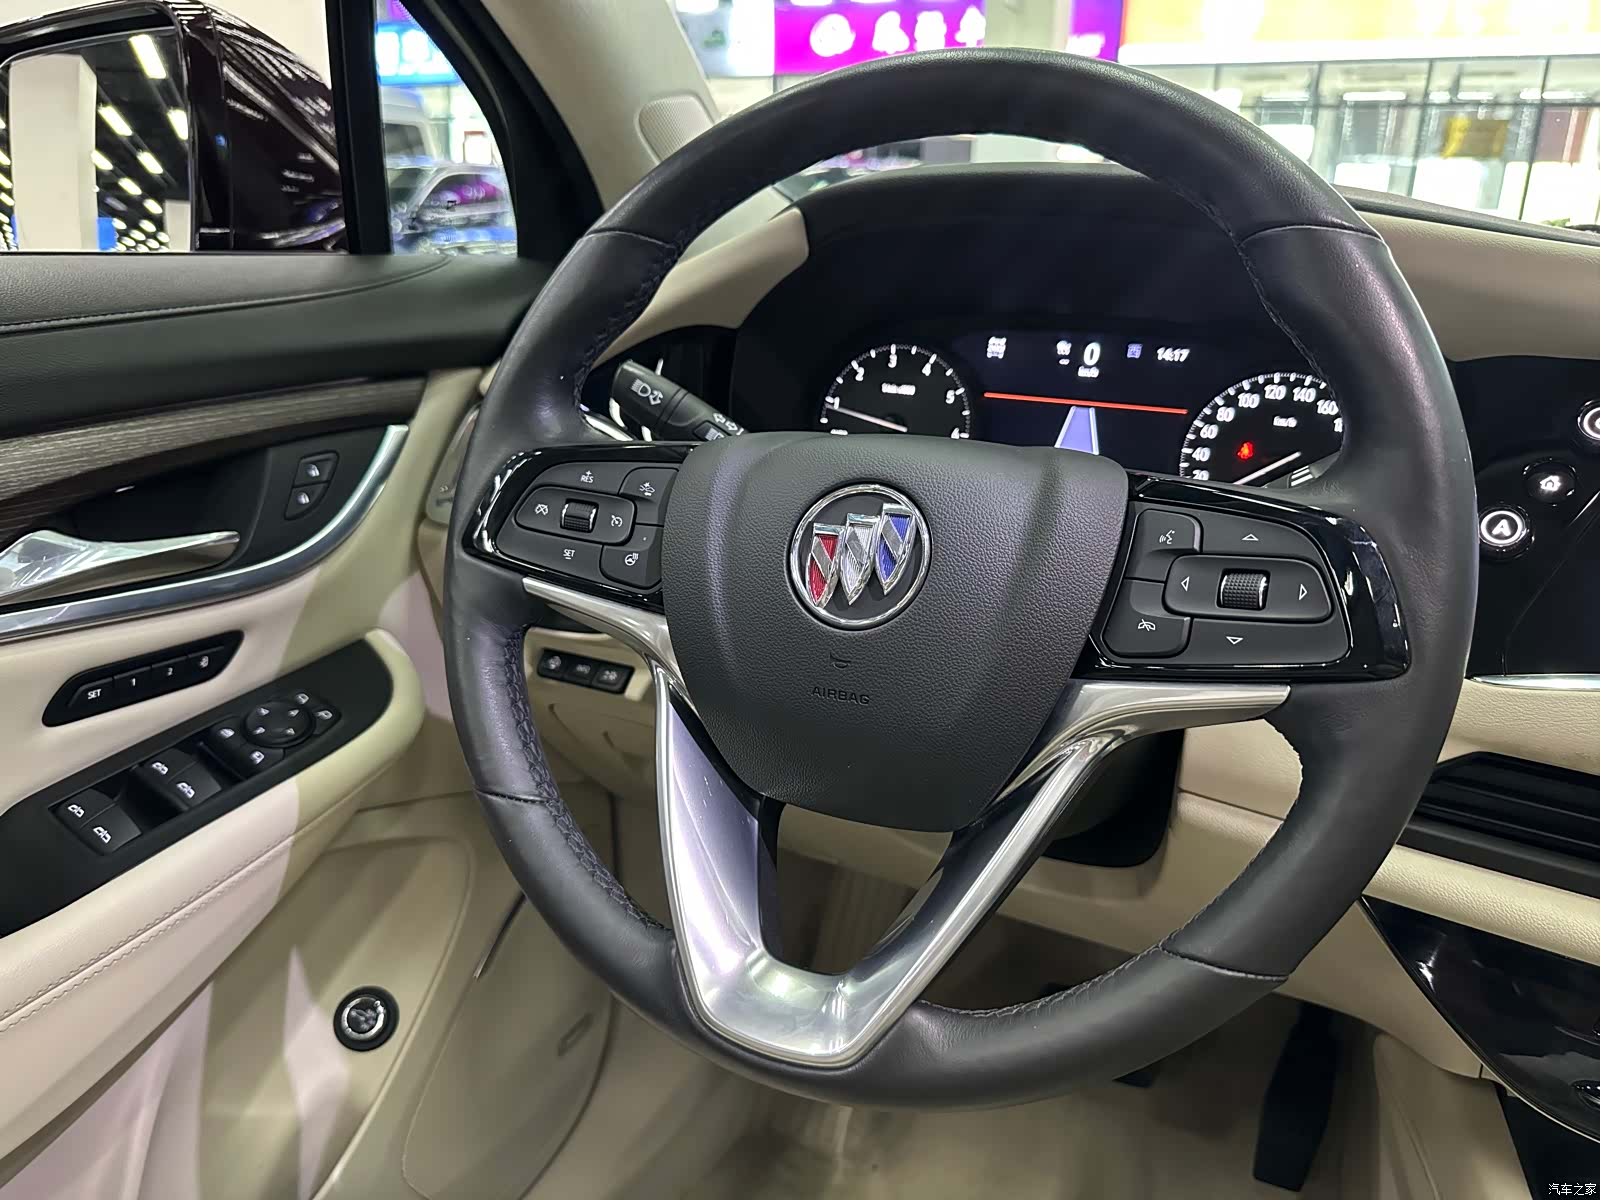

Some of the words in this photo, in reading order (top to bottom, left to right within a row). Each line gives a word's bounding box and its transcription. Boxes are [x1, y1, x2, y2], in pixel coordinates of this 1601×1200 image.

[888, 354, 898, 368] 3
[1083, 342, 1101, 366] 0
[1157, 347, 1190, 362] 14:17
[855, 366, 865, 382] 2
[922, 362, 932, 377] 4
[945, 389, 955, 404] 5
[1264, 384, 1287, 400] 120
[1293, 387, 1317, 403] 140
[833, 396, 840, 410] 1
[1237, 393, 1261, 409] 100
[1316, 399, 1339, 416] 160
[1216, 406, 1236, 423] 80
[1200, 424, 1219, 440] 60
[1191, 447, 1211, 462] 40
[580, 474, 594, 483] RES
[1192, 469, 1210, 480] 20
[563, 548, 576, 558] SET
[167, 667, 173, 676] 2
[131, 677, 137, 687] 1
[87, 688, 102, 700] SET
[811, 686, 871, 705] AIRBAG
